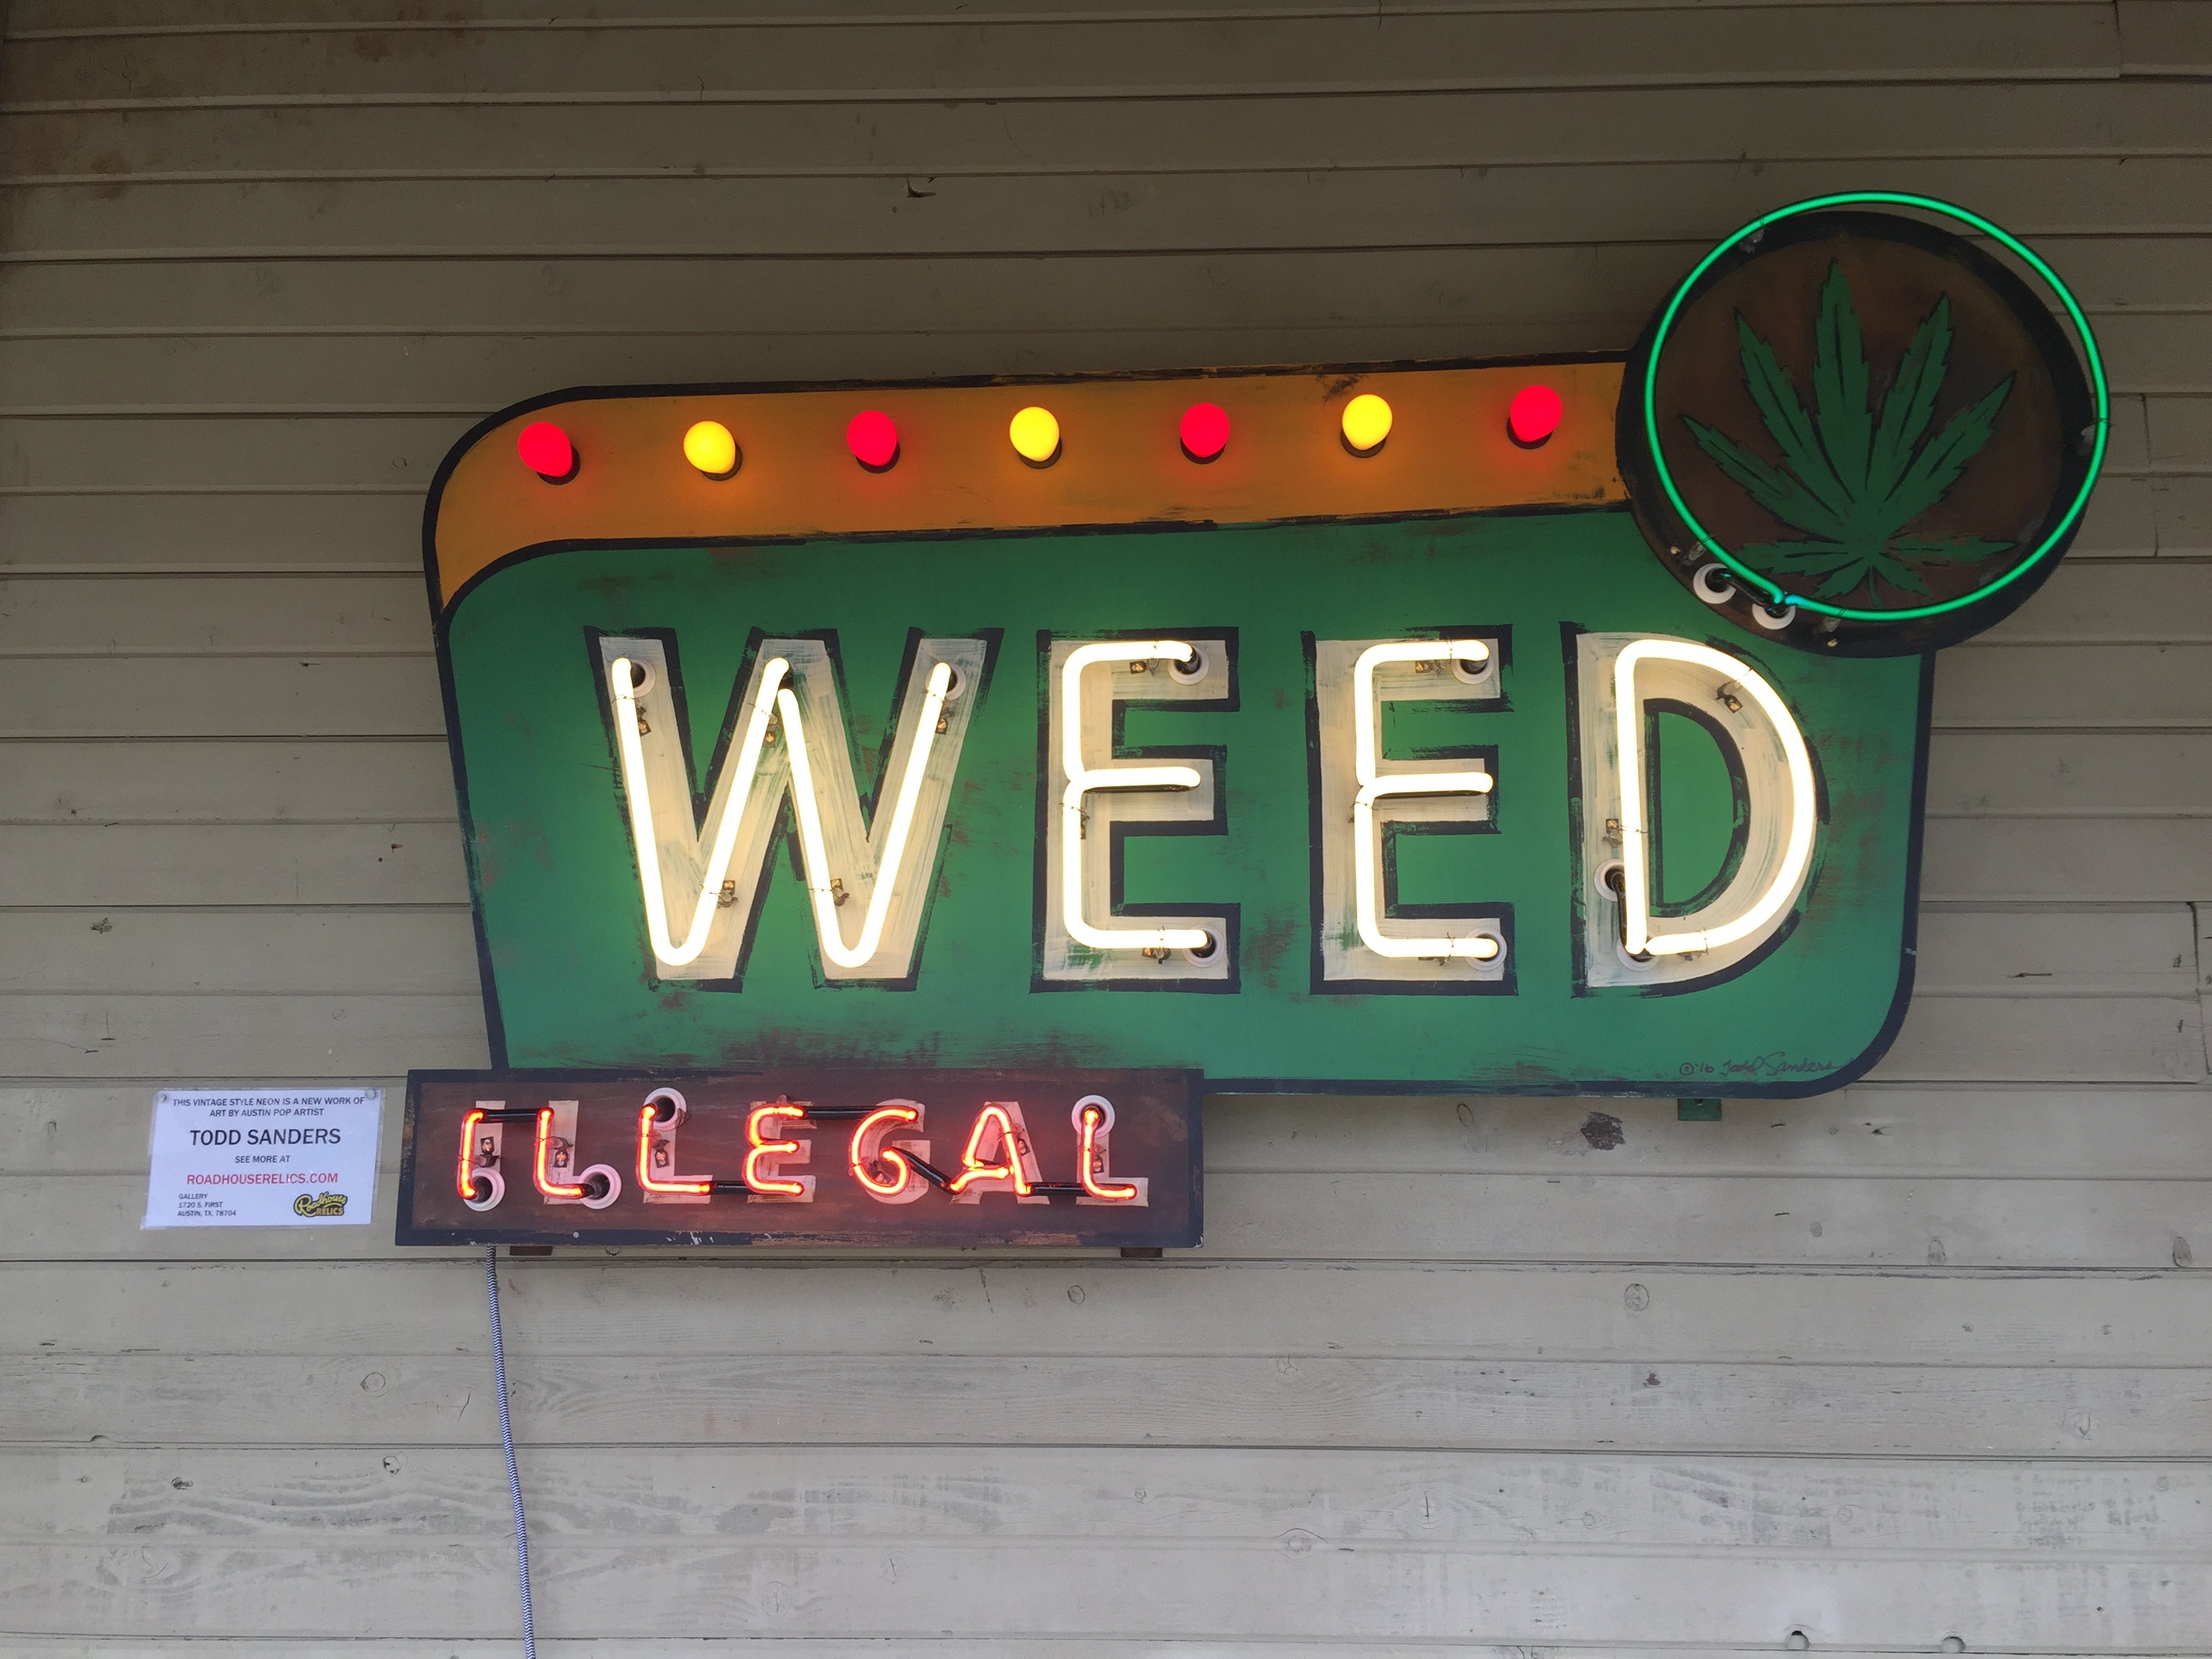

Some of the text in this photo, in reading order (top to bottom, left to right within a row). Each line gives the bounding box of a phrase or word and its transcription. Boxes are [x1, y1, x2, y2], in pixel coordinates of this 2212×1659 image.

[584, 621, 1828, 998] WEED
[190, 1128, 341, 1145] TODD SANDERS
[458, 1092, 1149, 1209] ILLEGAL
[186, 1173, 338, 1185] ROADHOUSERELICS.COM
[295, 1192, 346, 1216] Roadhouse
[316, 1207, 344, 1215] RELICS
